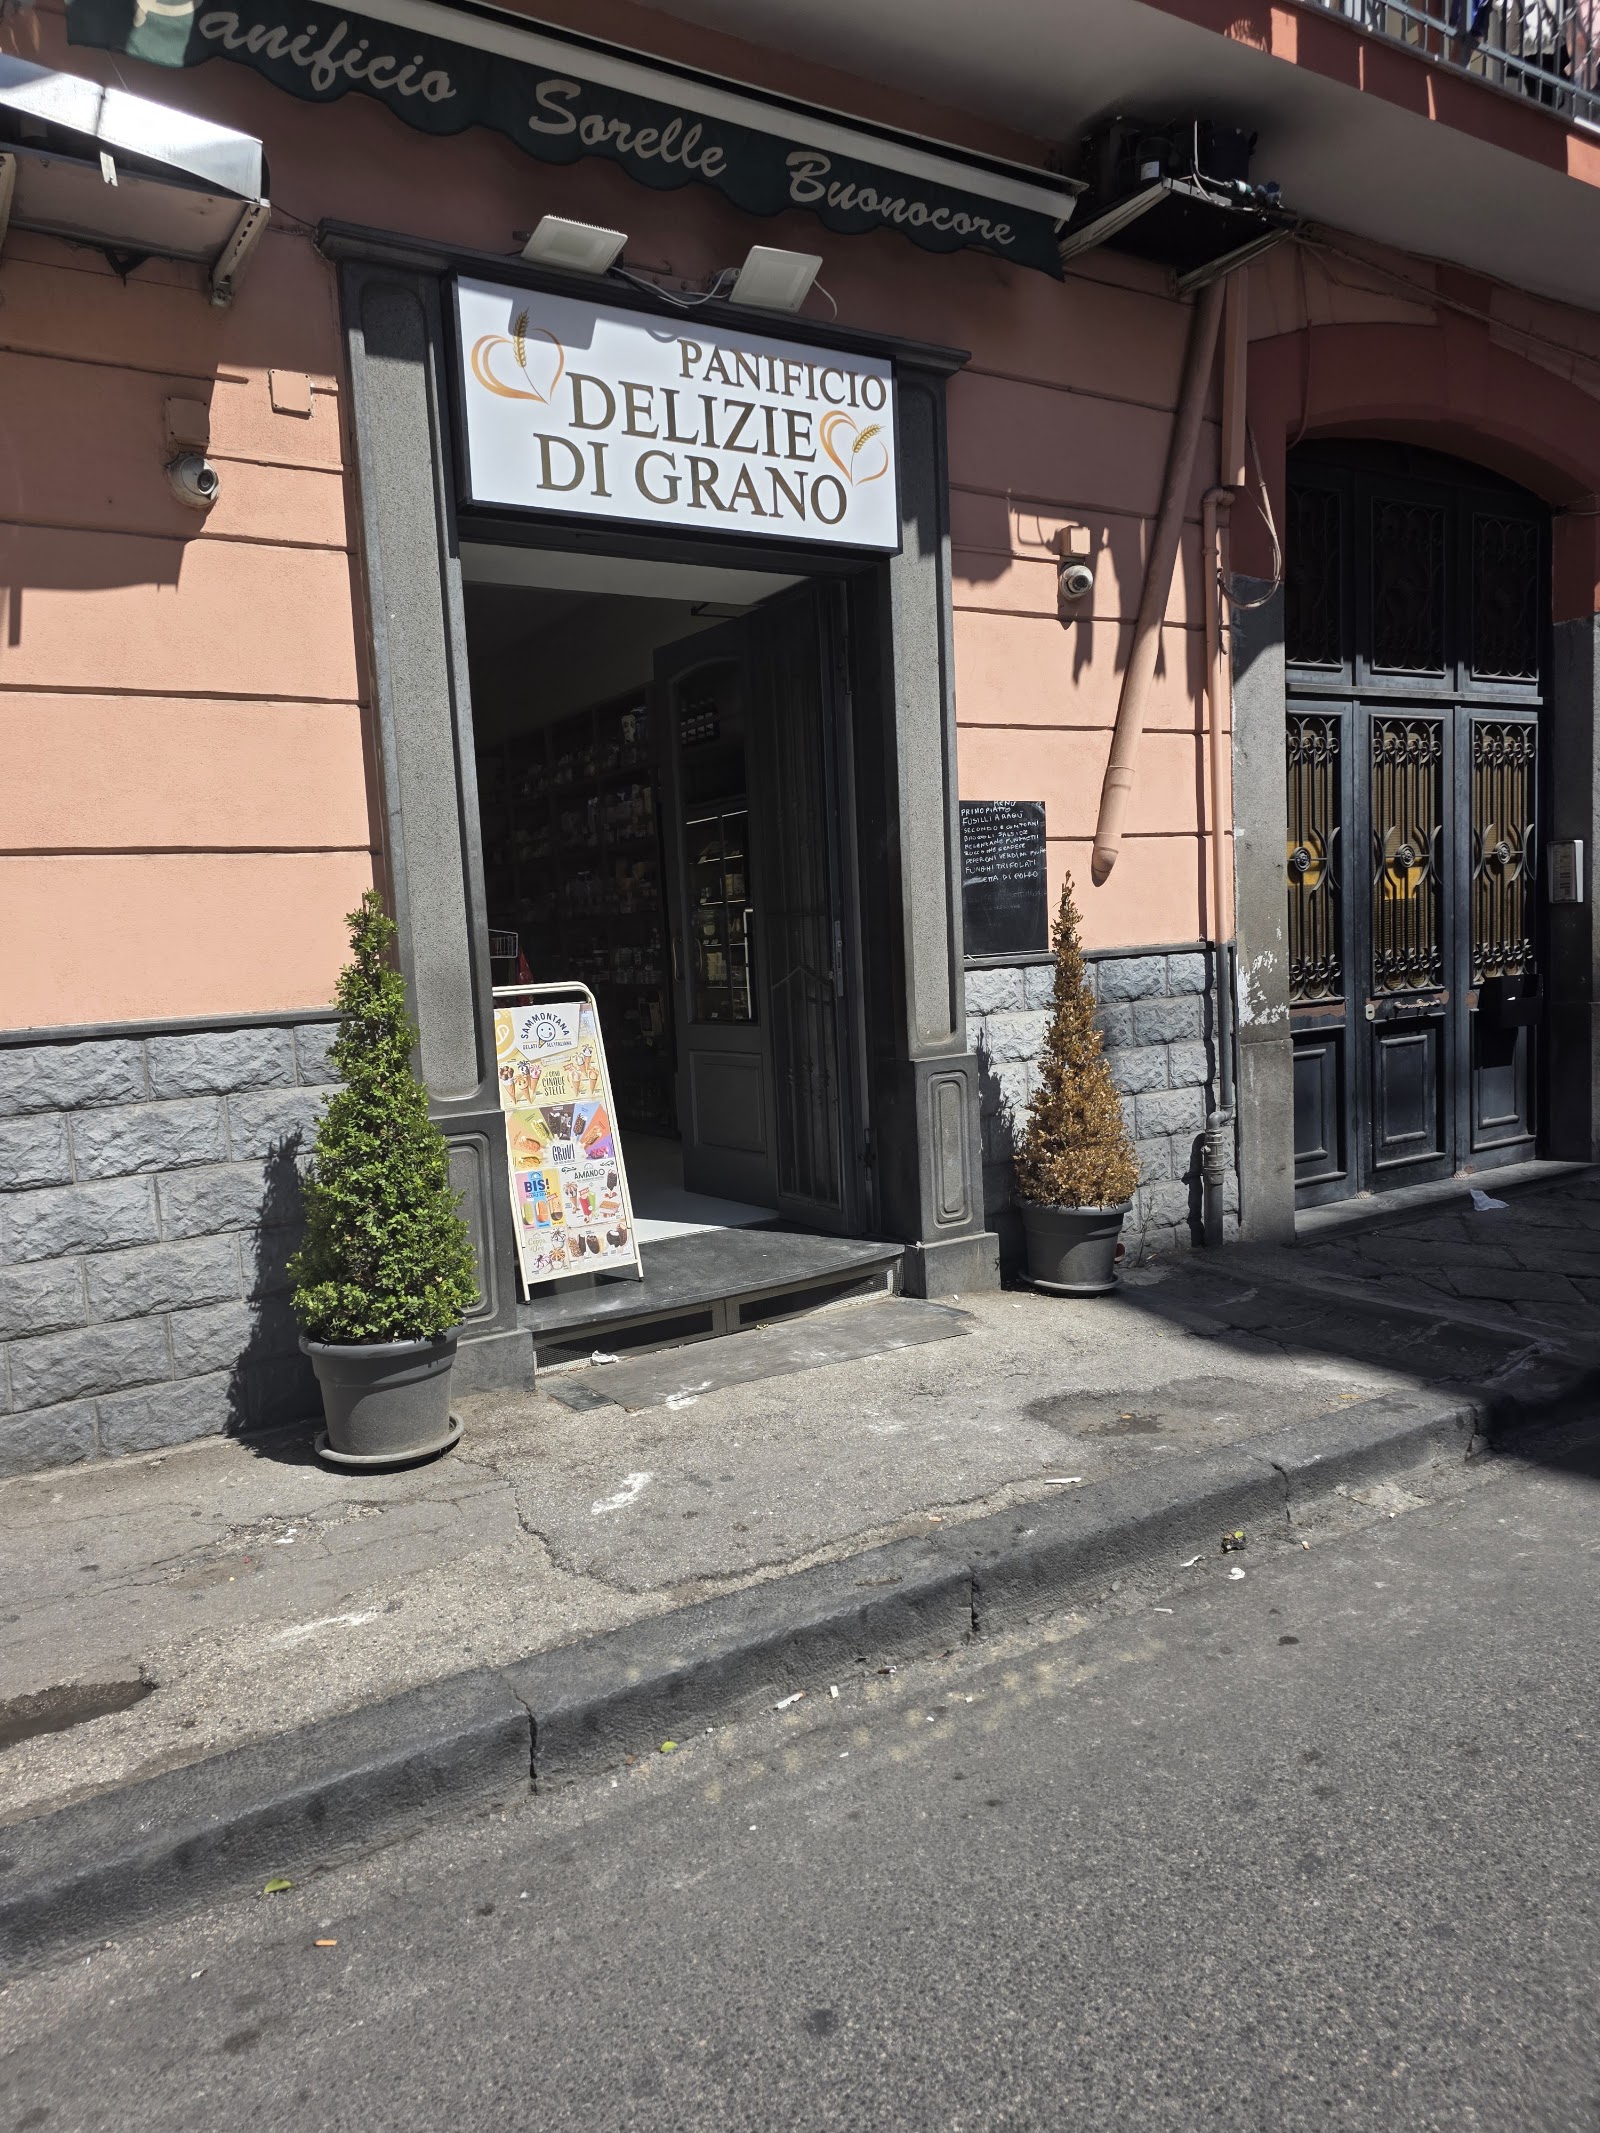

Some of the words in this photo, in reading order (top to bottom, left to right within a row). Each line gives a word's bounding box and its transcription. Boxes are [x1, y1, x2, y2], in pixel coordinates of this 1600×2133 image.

[529, 79, 727, 178] Sorelle
[786, 152, 1015, 245] Buonocore
[677, 339, 887, 411] PANIFICIO
[565, 371, 817, 462] DELIZIE
[533, 433, 613, 498] DI
[634, 450, 847, 525] GRANO
[961, 807, 984, 816] PRIMO
[985, 806, 1011, 814] PIATTO
[962, 815, 992, 826] FUSILLI
[964, 825, 998, 833] SECONDO
[965, 864, 994, 874] FUNGHI
[996, 859, 1036, 870] TRIFOLATI
[521, 1012, 570, 1039] SAMMONTANA
[574, 1168, 606, 1179] AMANDO
[524, 1178, 550, 1193] BIS!
